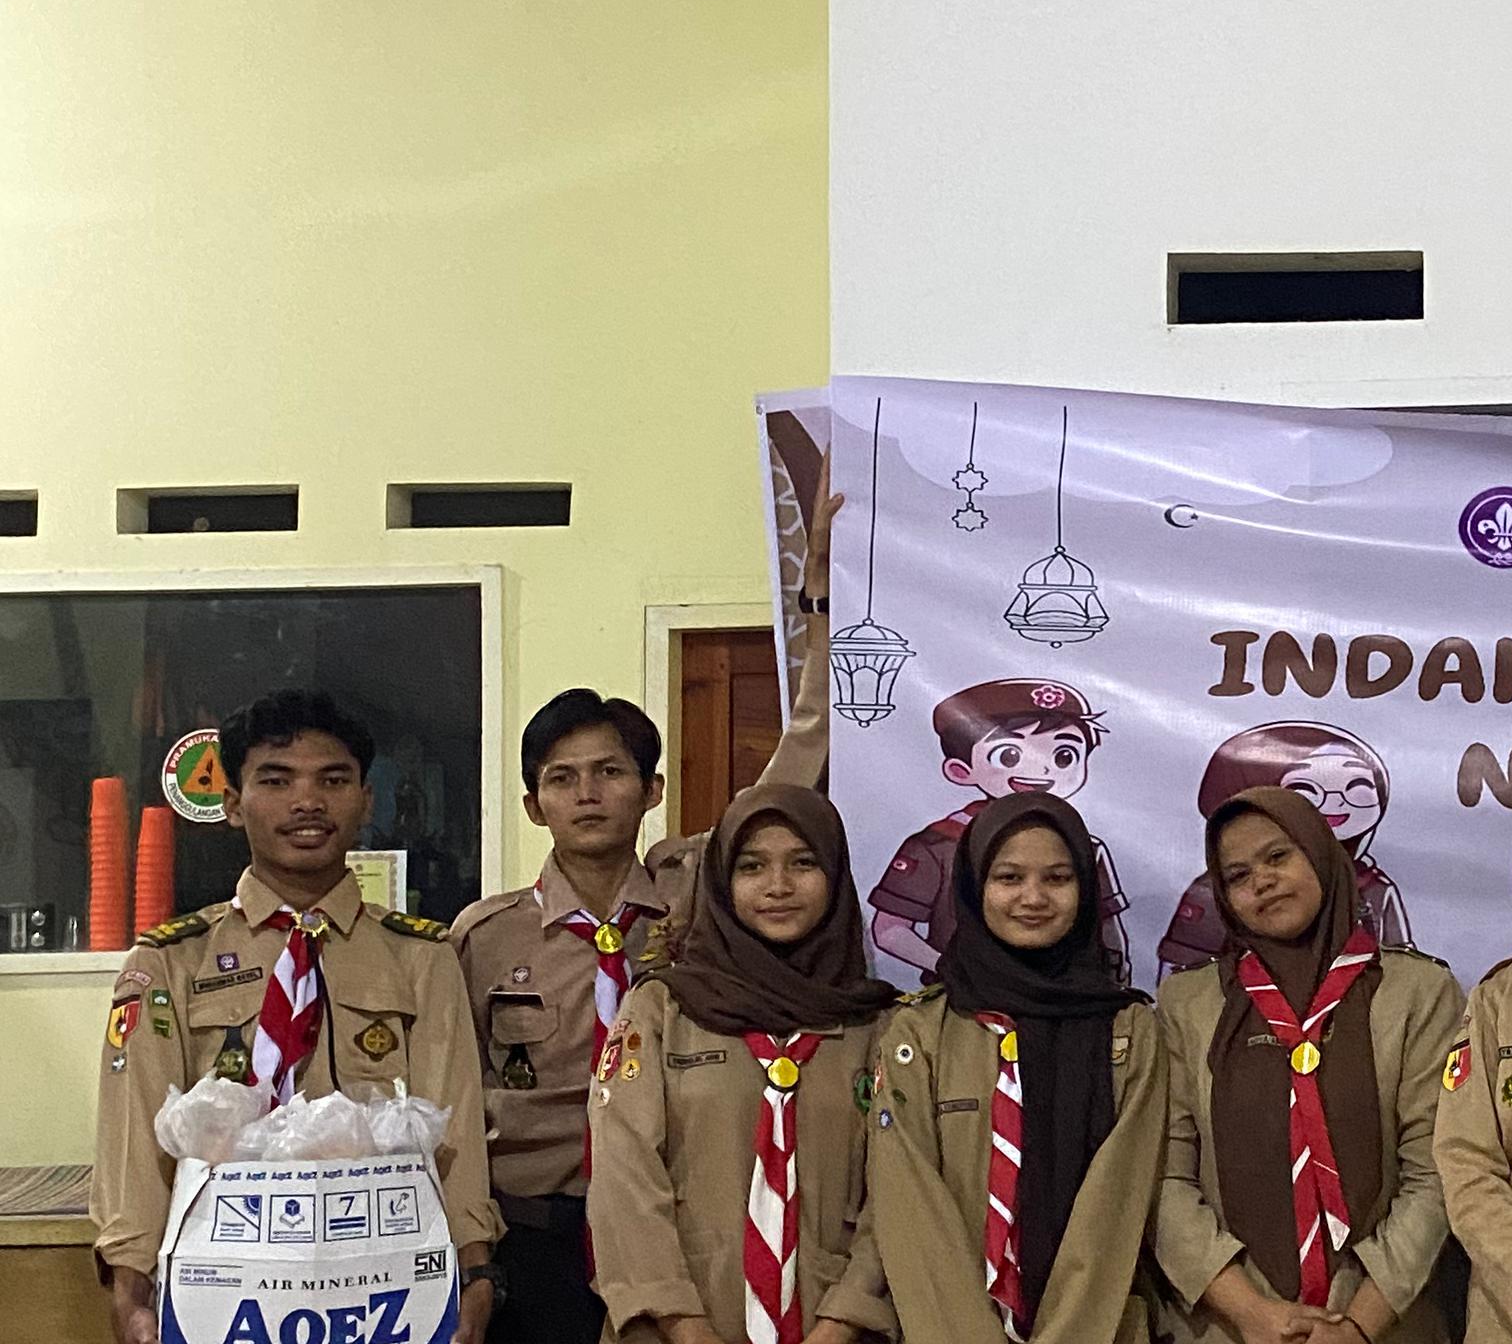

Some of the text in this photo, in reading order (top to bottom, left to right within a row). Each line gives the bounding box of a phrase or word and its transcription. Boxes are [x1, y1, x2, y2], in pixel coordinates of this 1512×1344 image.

[169, 735, 220, 769] PRAMUKA
[257, 1272, 393, 1291] AIR MINERAL
